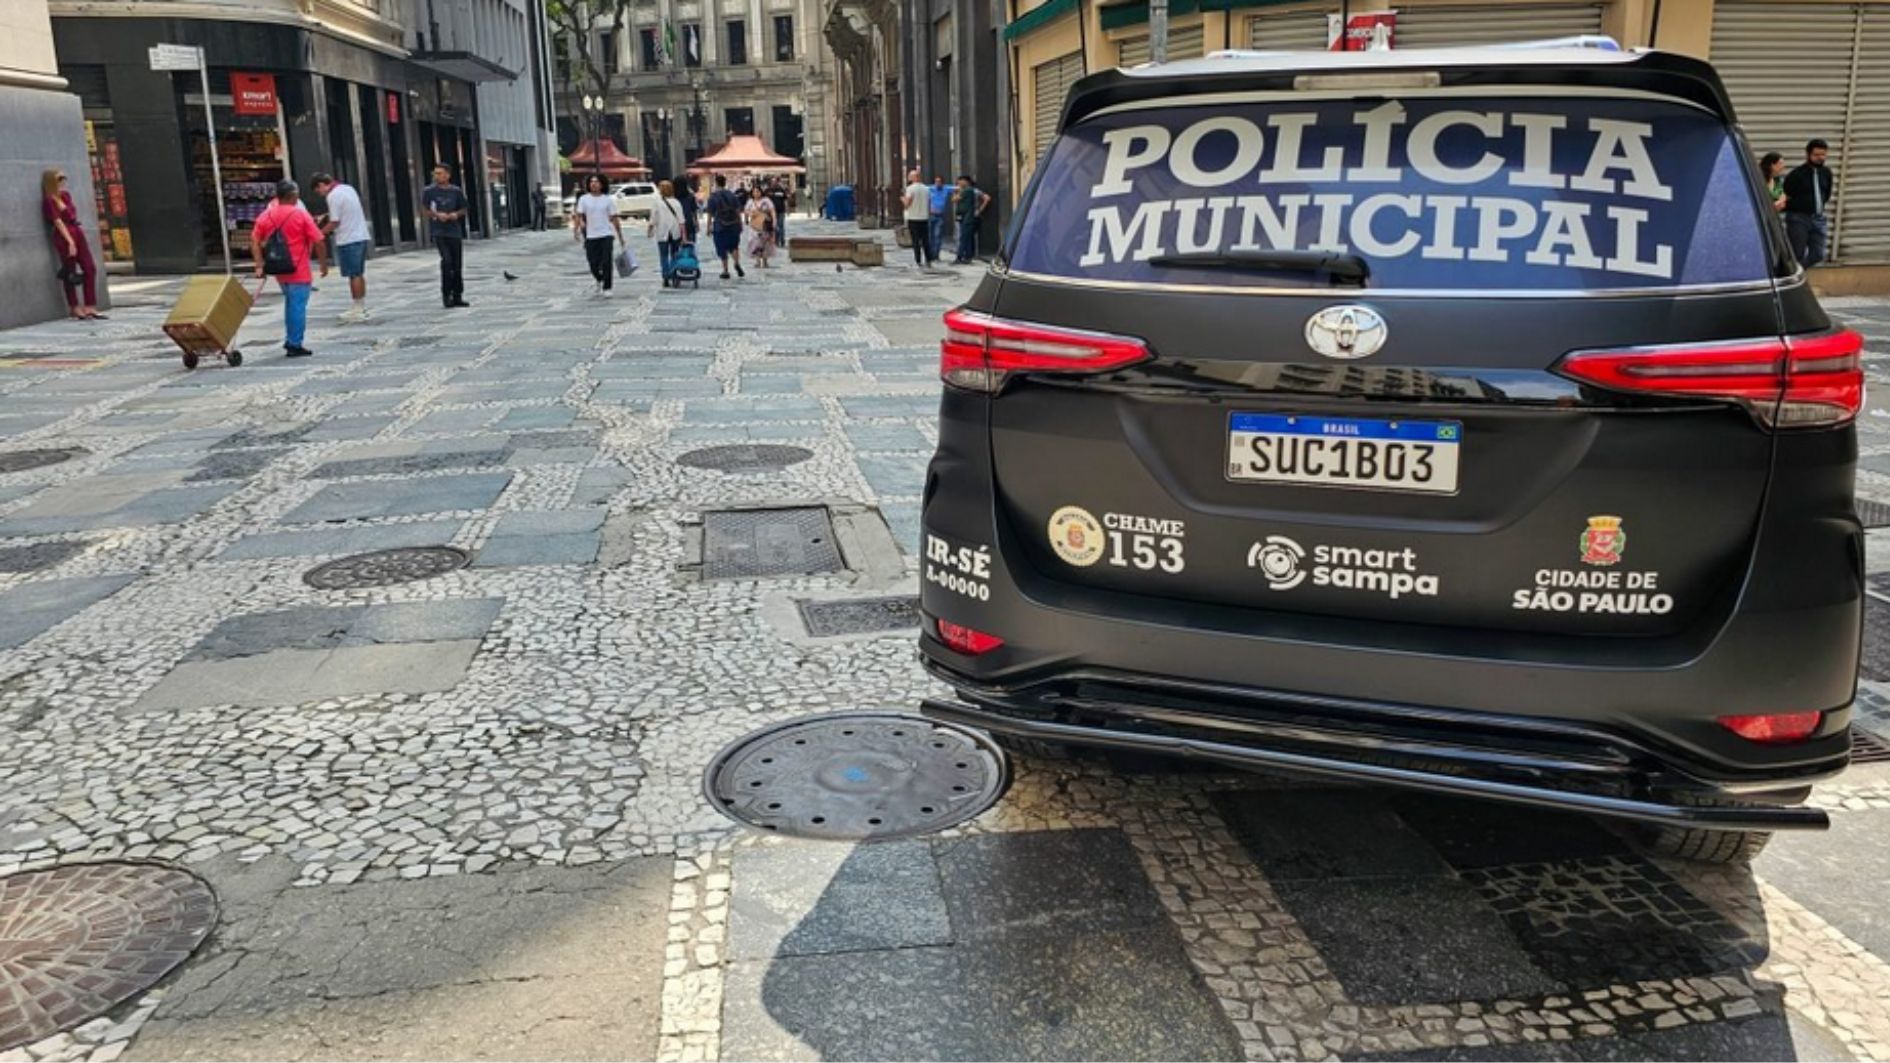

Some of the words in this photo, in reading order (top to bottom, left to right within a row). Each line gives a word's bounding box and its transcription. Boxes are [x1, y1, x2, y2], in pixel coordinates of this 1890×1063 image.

[1090, 99, 1673, 201] POLÍCIA
[1079, 193, 1673, 279] MUNICIPAL
[1322, 422, 1361, 436] BRASIL
[1250, 436, 1434, 482] SUC1B03
[1103, 512, 1185, 537] CHAME
[926, 534, 991, 579] IR-SÉ
[1109, 531, 1185, 574] 153
[1313, 545, 1416, 571] smart
[1312, 565, 1439, 599] sampa
[1535, 569, 1621, 589] CIDADE
[1626, 571, 1658, 589] DE
[1512, 586, 1574, 611] SÃO
[1578, 593, 1674, 614] PAULO
